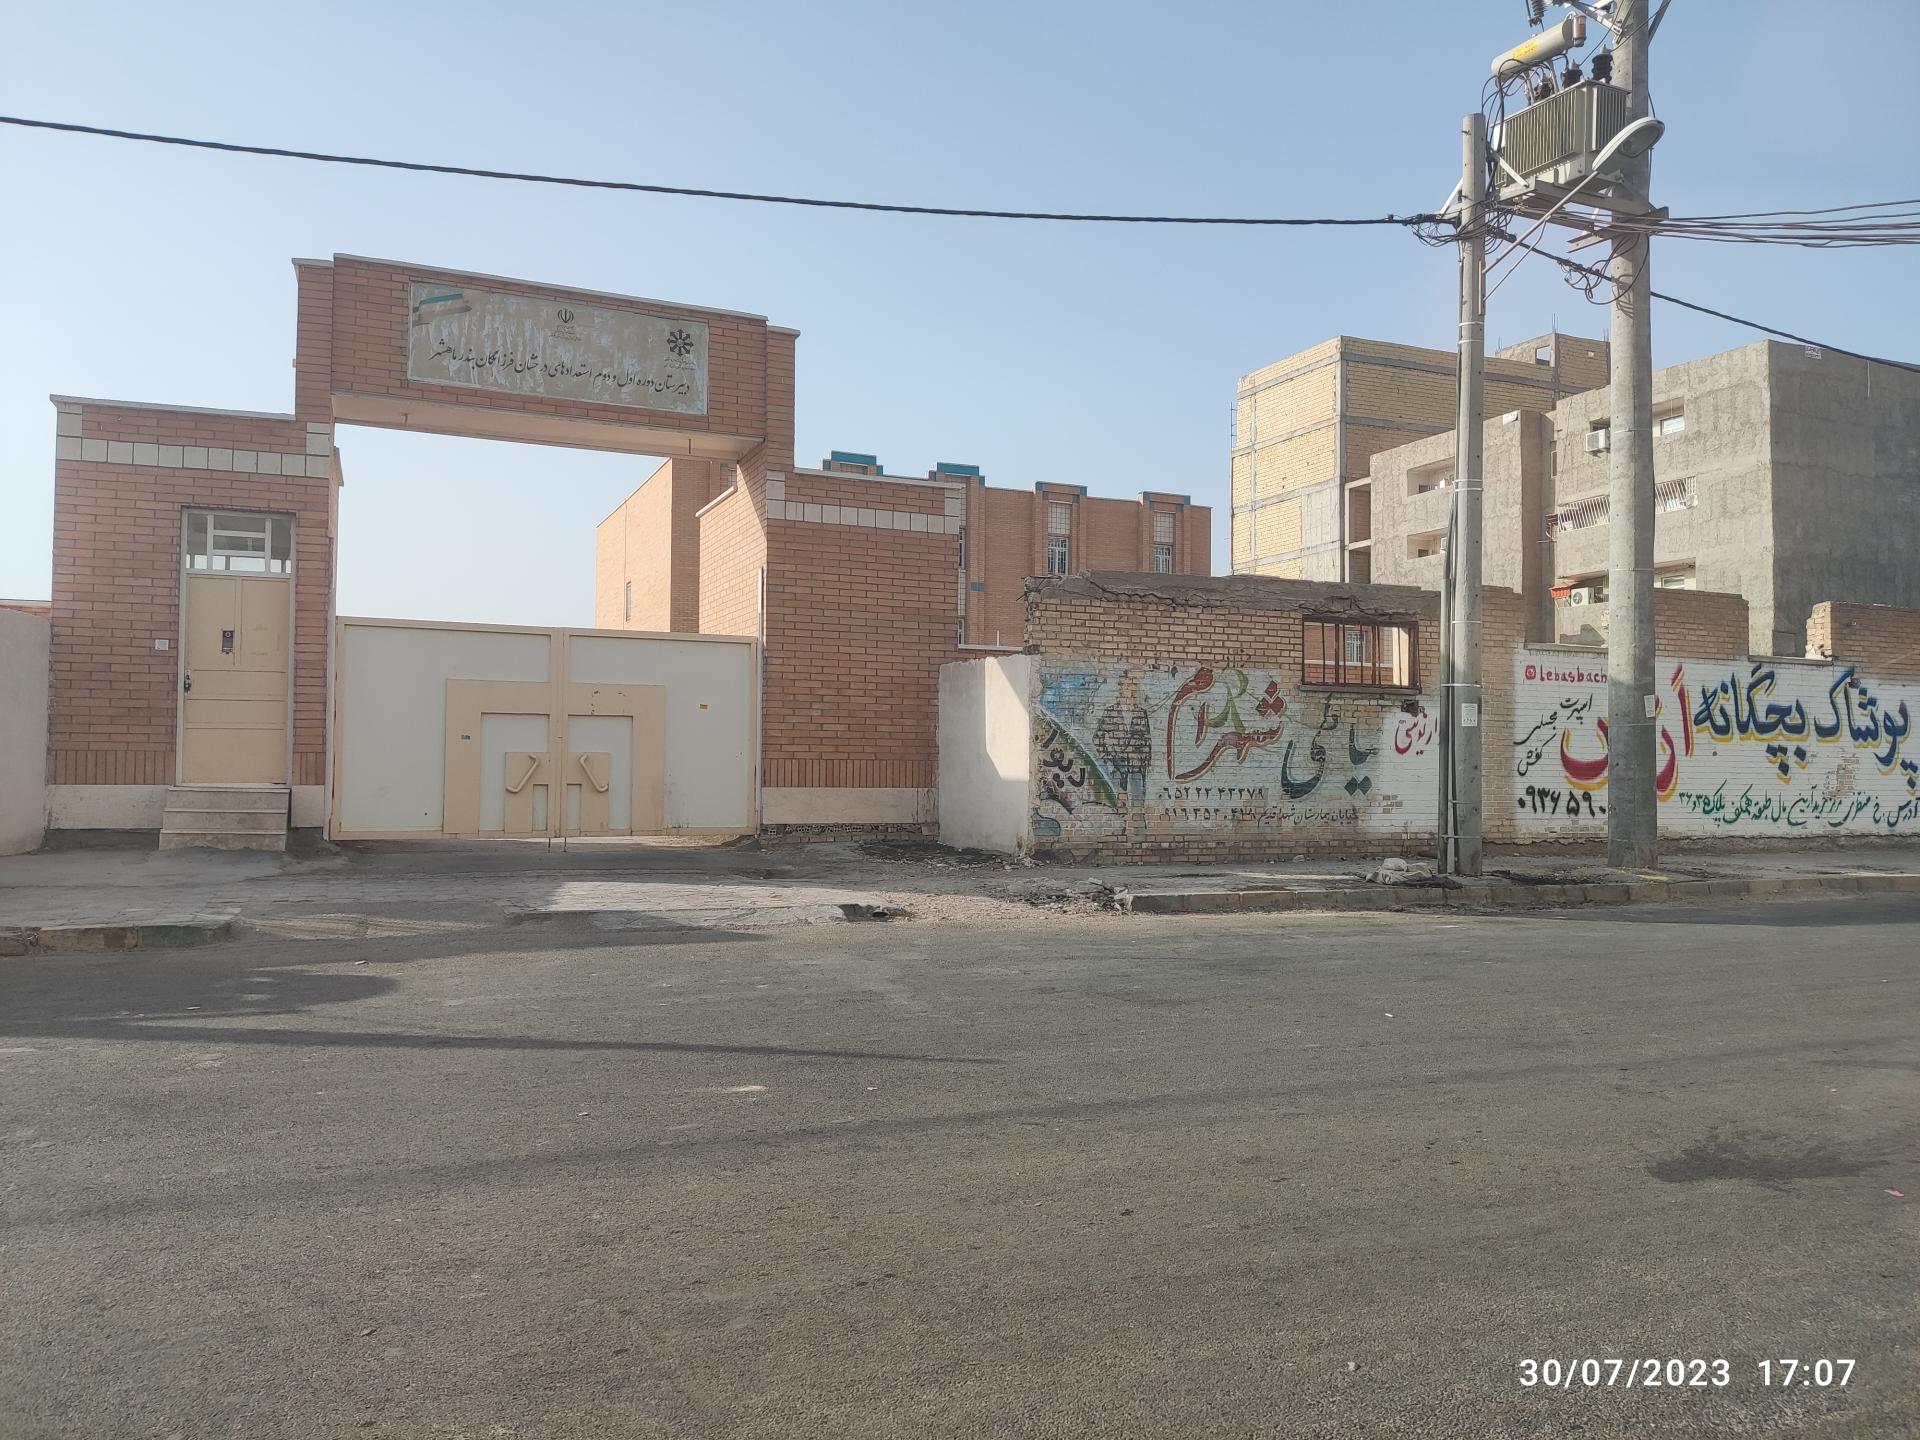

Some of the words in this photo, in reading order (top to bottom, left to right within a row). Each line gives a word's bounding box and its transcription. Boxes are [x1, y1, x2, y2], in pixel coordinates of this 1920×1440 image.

[428, 338, 457, 361] ماهشهر
[459, 348, 476, 370] بندر
[475, 350, 515, 371] فرزانگان
[514, 353, 548, 374] درخشان
[593, 370, 611, 388] دوم
[617, 367, 636, 388] اول
[637, 378, 655, 388] دوره
[655, 374, 690, 395] دبیرستان
[1540, 663, 1608, 683] lebasbach
[1560, 693, 1593, 725] اسپرت
[1166, 666, 1287, 783] شهرام
[1694, 663, 1809, 786] بچگانه
[1814, 664, 1919, 792] پوشاک
[1517, 733, 1557, 776] کفش
[1723, 783, 1753, 824] همکف
